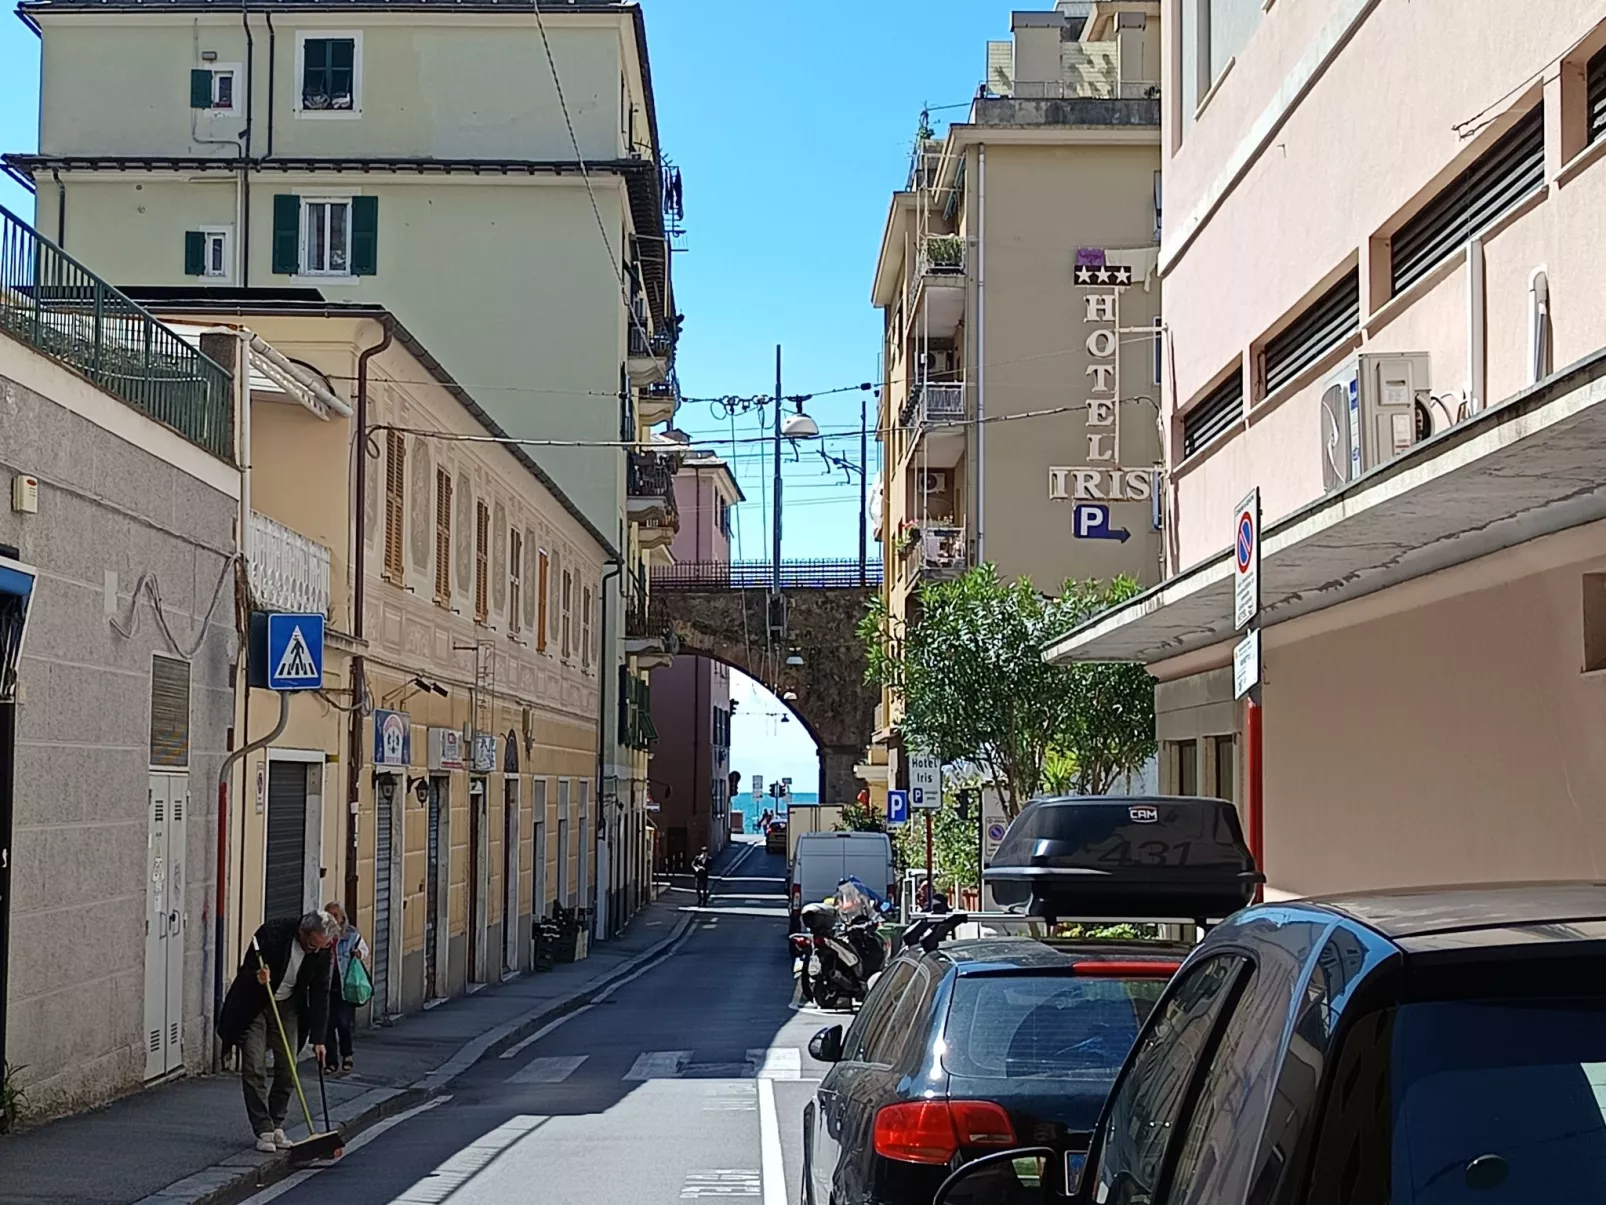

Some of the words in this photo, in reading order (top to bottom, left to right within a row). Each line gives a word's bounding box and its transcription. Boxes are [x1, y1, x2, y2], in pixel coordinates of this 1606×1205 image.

[1083, 294, 1116, 462] HOTEL
[1053, 470, 1150, 500] IRIS
[1080, 508, 1103, 535] P
[911, 757, 938, 768] Hotel
[917, 772, 933, 783] Iris
[891, 794, 903, 818] P
[1130, 809, 1158, 819] CAM
